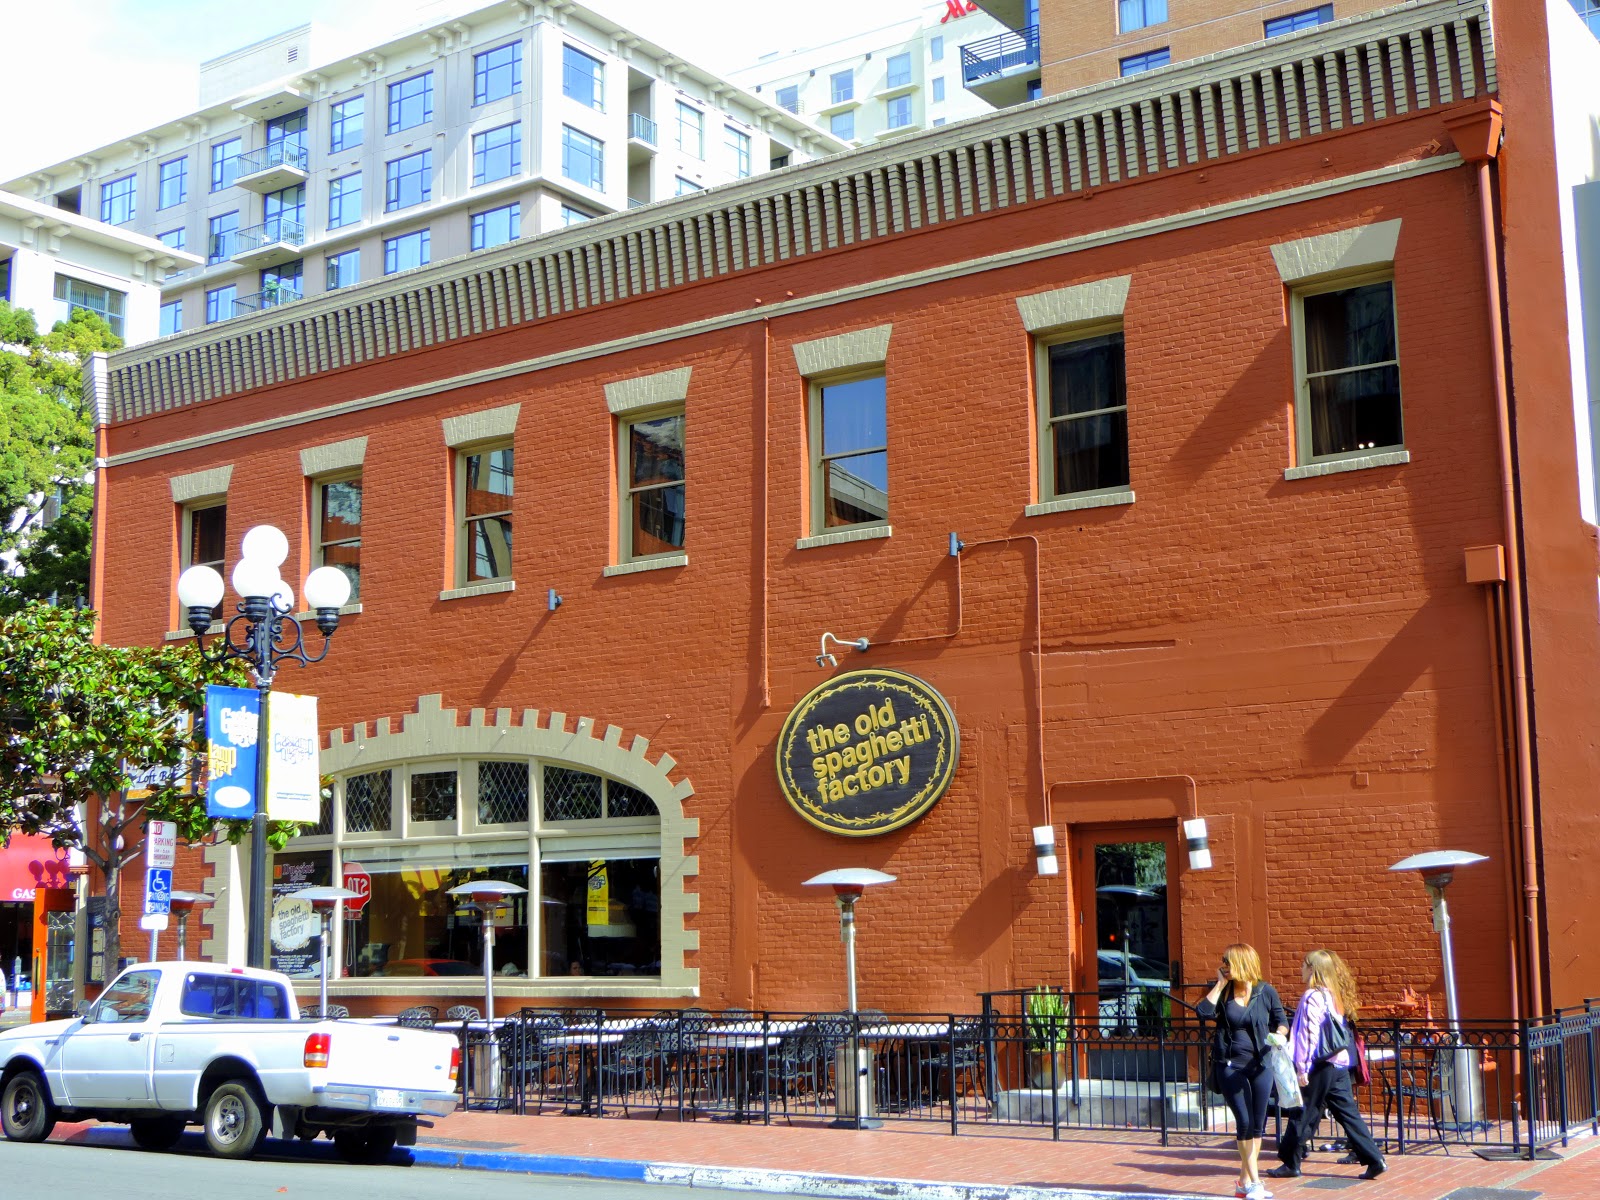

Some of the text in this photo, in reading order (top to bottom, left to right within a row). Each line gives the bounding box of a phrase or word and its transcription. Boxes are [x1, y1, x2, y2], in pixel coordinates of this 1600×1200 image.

[806, 697, 897, 755] the old
[812, 713, 931, 780] spaghetti
[817, 755, 911, 804] factory
[278, 904, 301, 920] the old
[279, 909, 310, 931] spaghetti
[279, 922, 305, 940] factory
